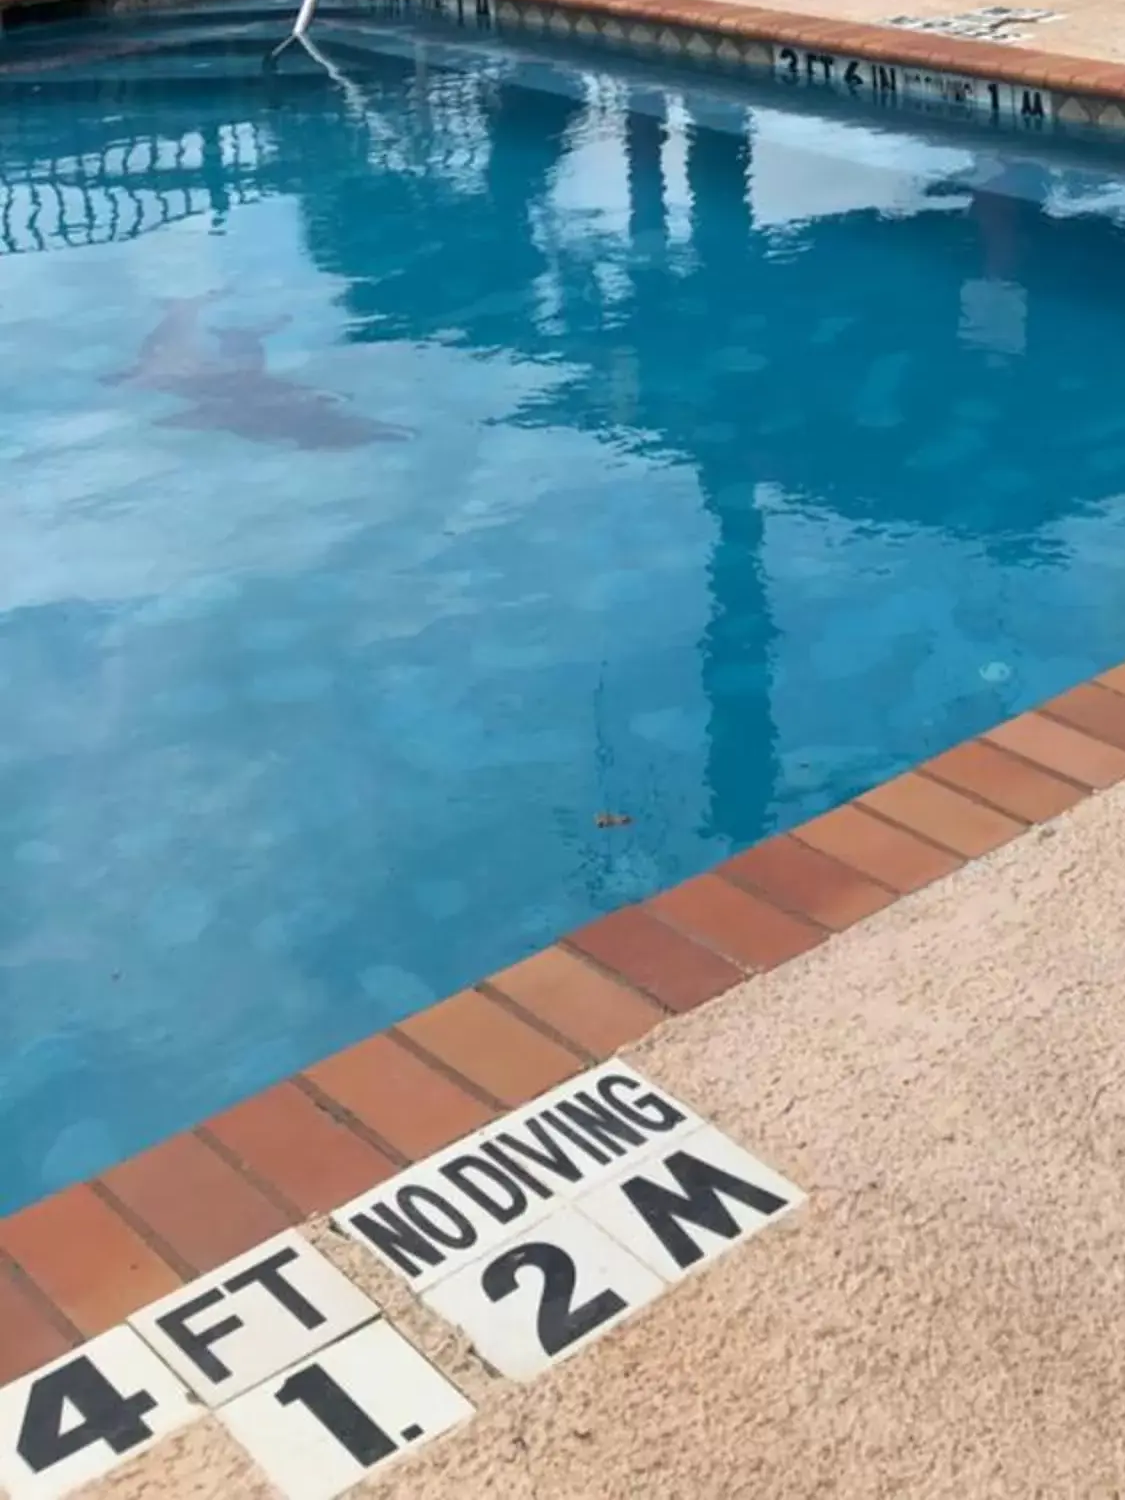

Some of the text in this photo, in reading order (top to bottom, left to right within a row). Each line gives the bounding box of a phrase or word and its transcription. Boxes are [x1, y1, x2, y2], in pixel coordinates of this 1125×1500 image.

[843, 61, 864, 85] 6
[871, 65, 897, 91] IN
[987, 83, 999, 109] 1
[349, 1073, 688, 1279] NO DIVING
[620, 1149, 792, 1270] M
[15, 1246, 329, 1475] 4 FT
